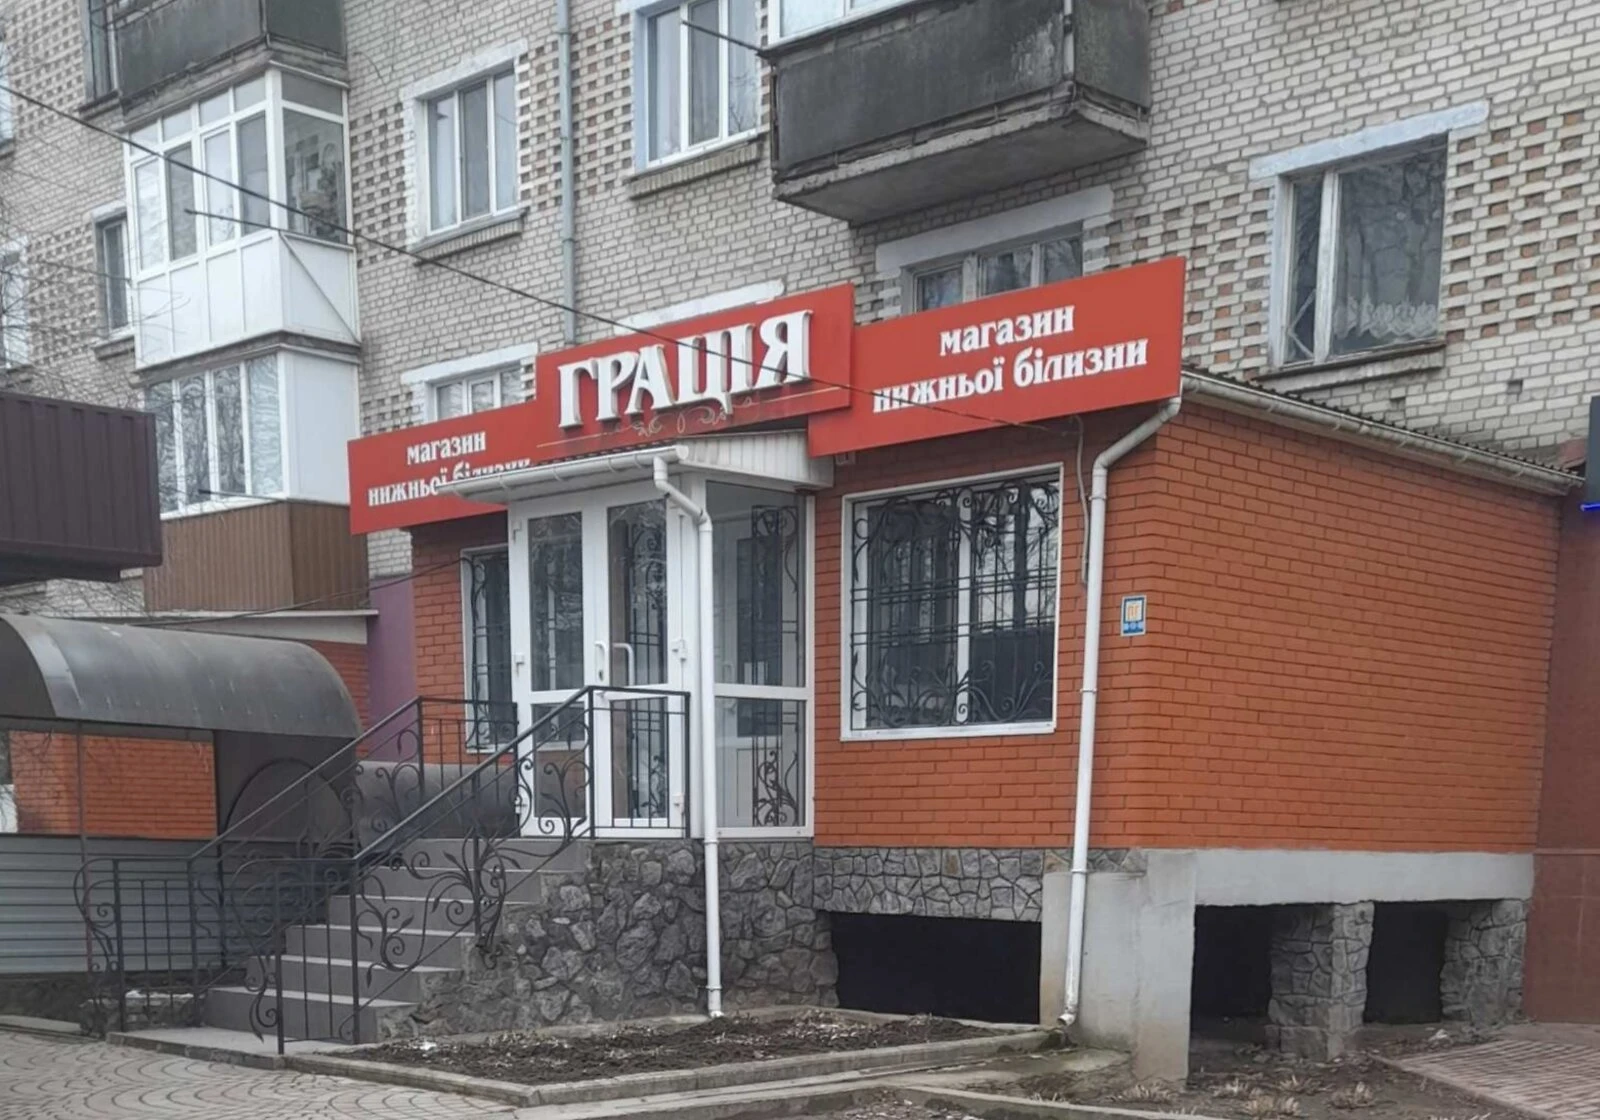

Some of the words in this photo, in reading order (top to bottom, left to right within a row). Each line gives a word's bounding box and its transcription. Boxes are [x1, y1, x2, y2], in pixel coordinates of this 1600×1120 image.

[940, 305, 1074, 355] магазин
[557, 309, 813, 428] ГРАЦІЯ
[873, 357, 1004, 412] нижньої
[1013, 339, 1148, 387] білизни
[407, 431, 486, 465] магазин
[368, 467, 448, 506] нижньої
